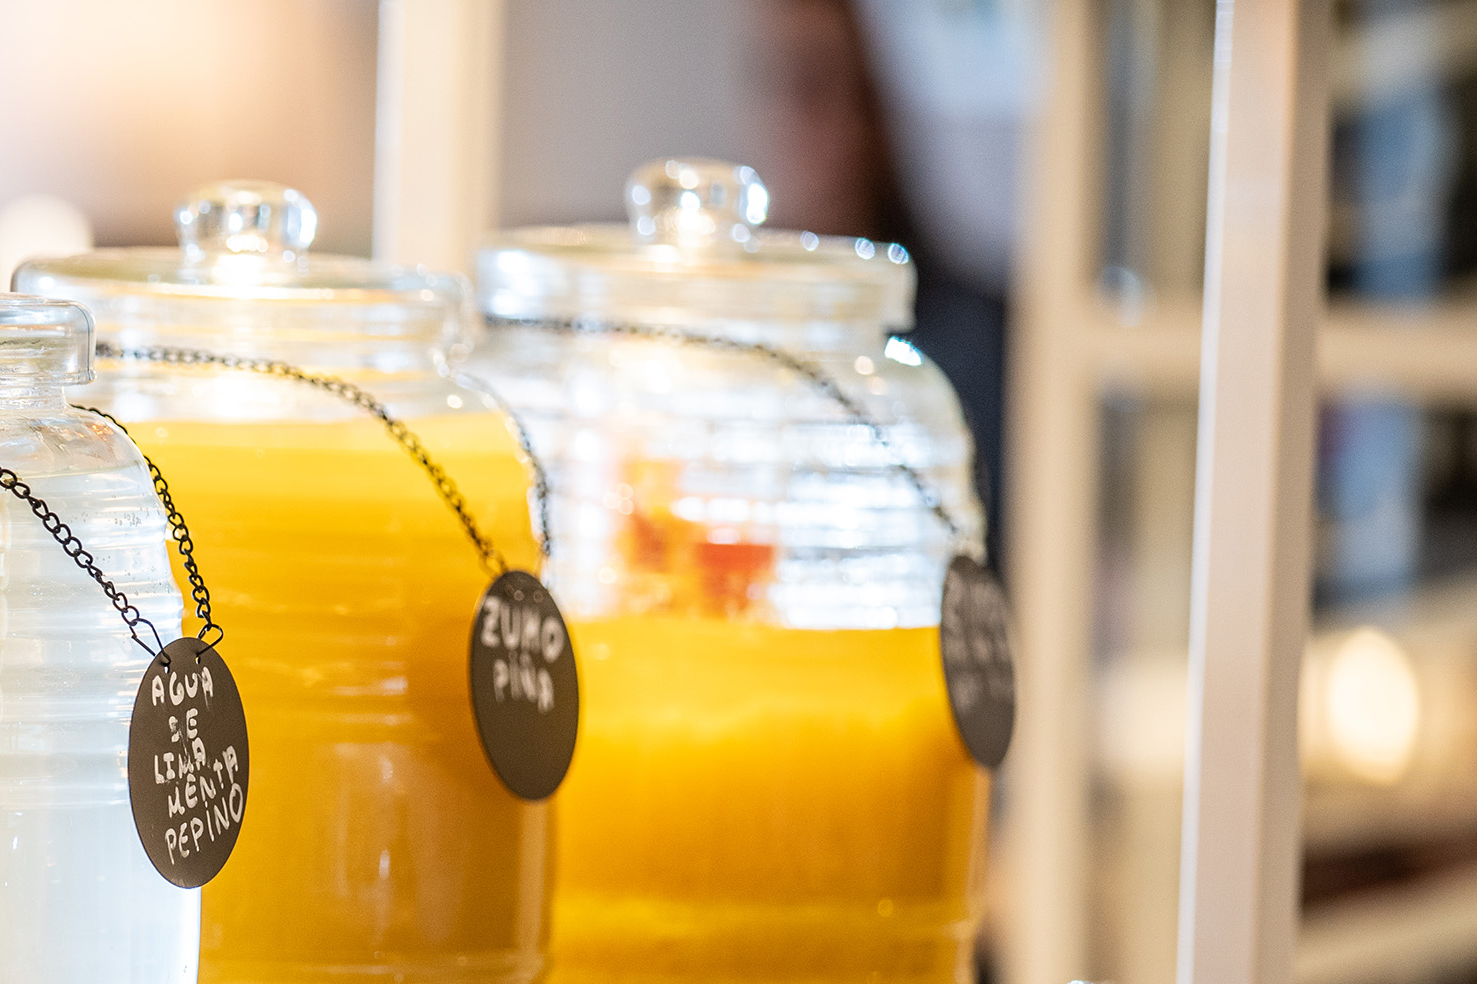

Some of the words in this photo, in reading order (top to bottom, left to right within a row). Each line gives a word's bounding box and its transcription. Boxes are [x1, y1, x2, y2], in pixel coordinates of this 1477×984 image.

[480, 595, 565, 663] ZUMO
[151, 666, 214, 706] AGUA
[154, 737, 207, 784] LIMA
[167, 745, 239, 818] MENTA
[164, 782, 244, 865] PEPINO
